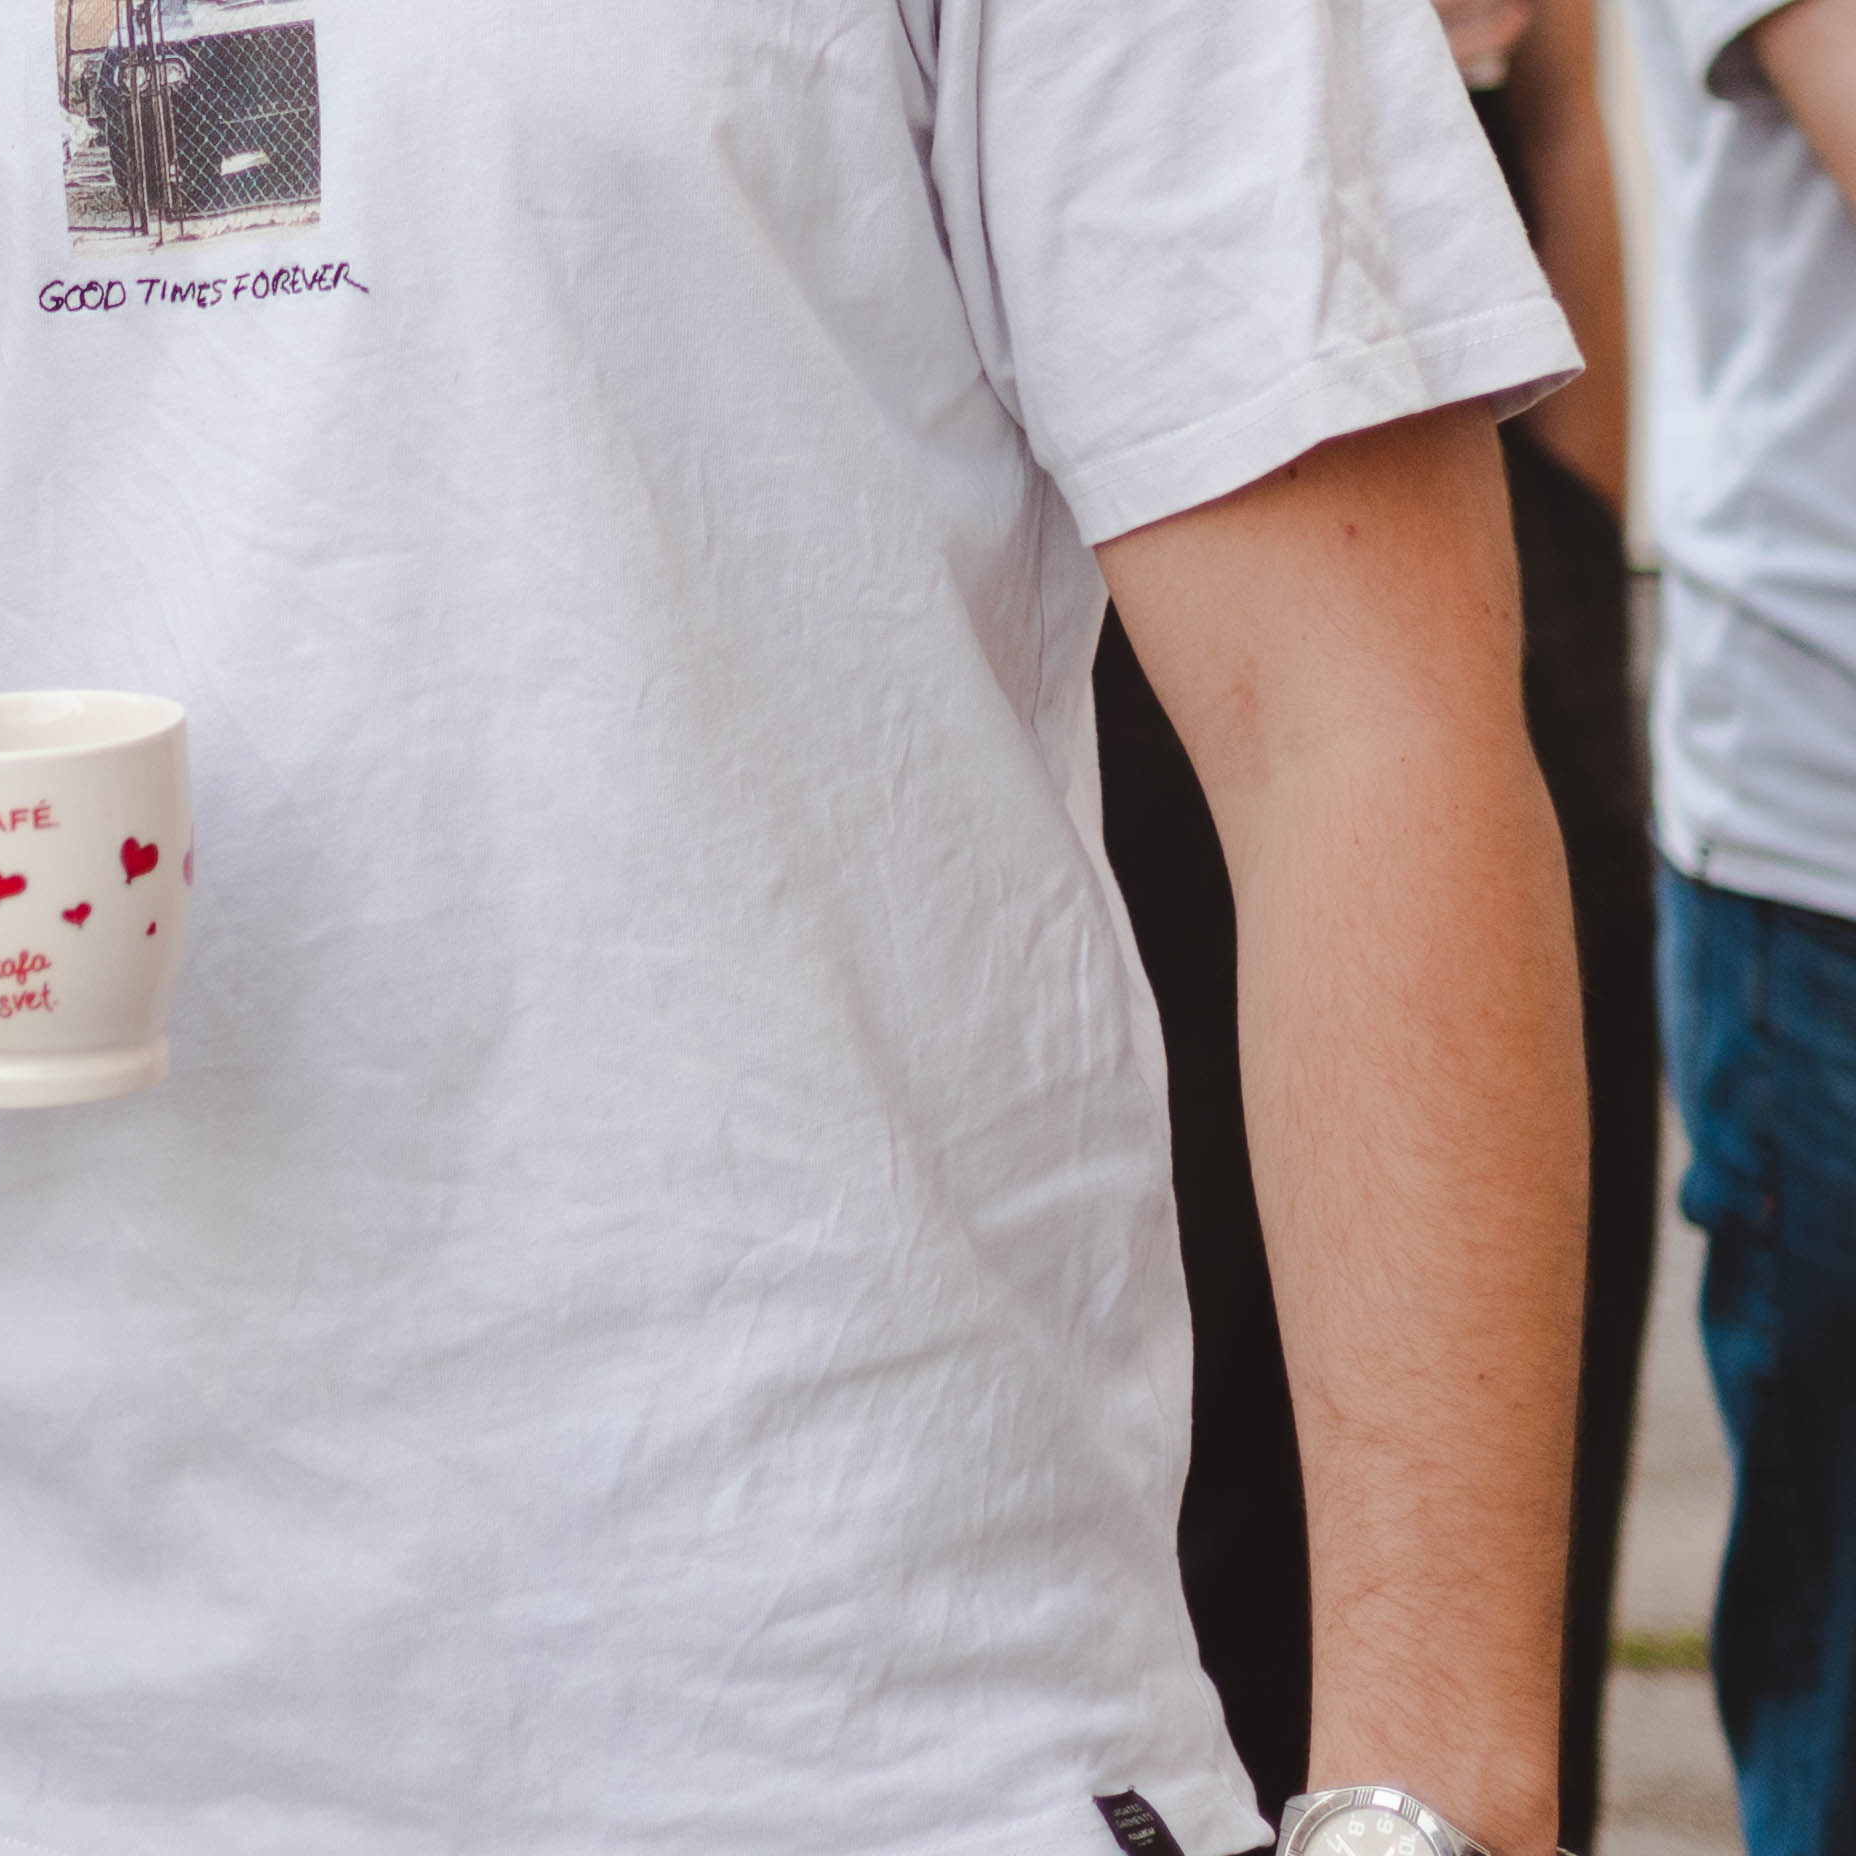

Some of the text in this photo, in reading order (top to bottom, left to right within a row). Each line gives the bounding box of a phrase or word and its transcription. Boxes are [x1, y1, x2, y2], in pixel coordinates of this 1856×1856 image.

[38, 261, 369, 312] GOOD TIMES FOREVER
